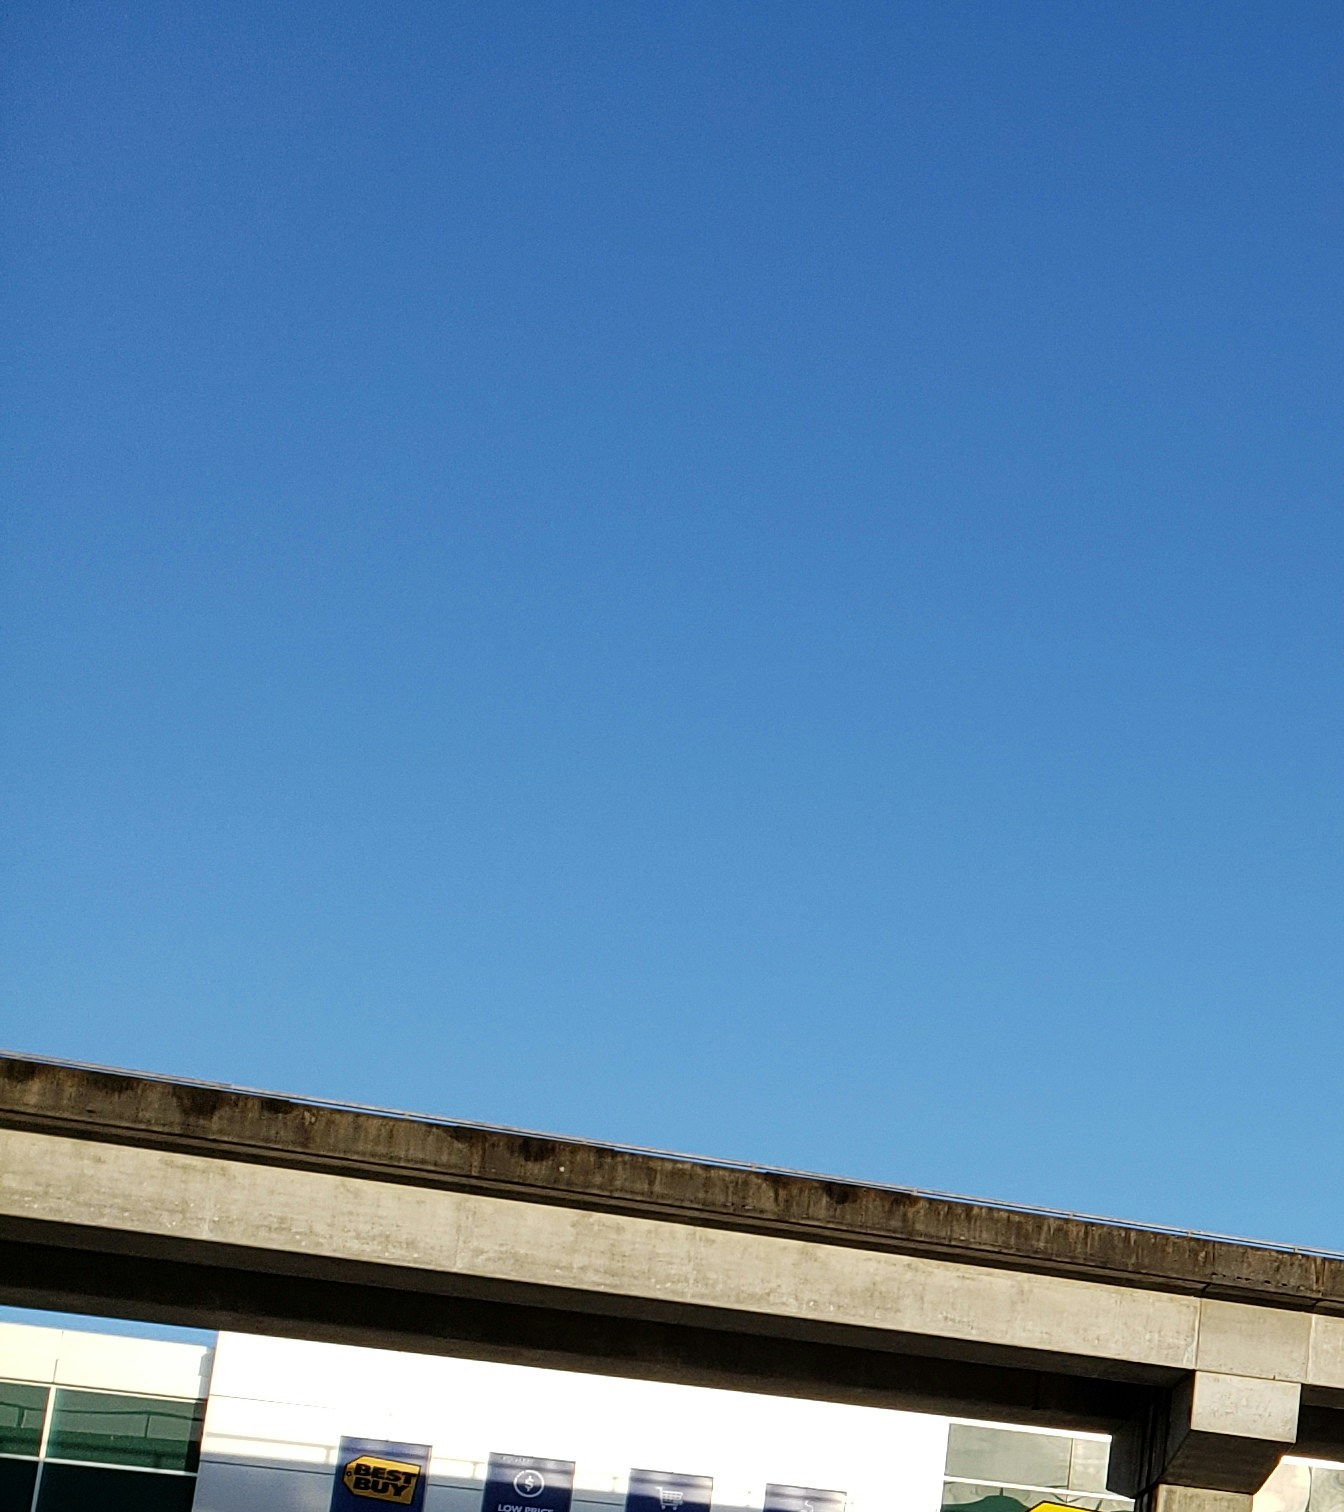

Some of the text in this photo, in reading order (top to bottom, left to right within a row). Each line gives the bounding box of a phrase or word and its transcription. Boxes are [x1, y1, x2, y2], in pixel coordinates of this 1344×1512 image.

[354, 1463, 417, 1484] BEST
[353, 1477, 409, 1496] BUY
[497, 1504, 523, 1512] LOW
